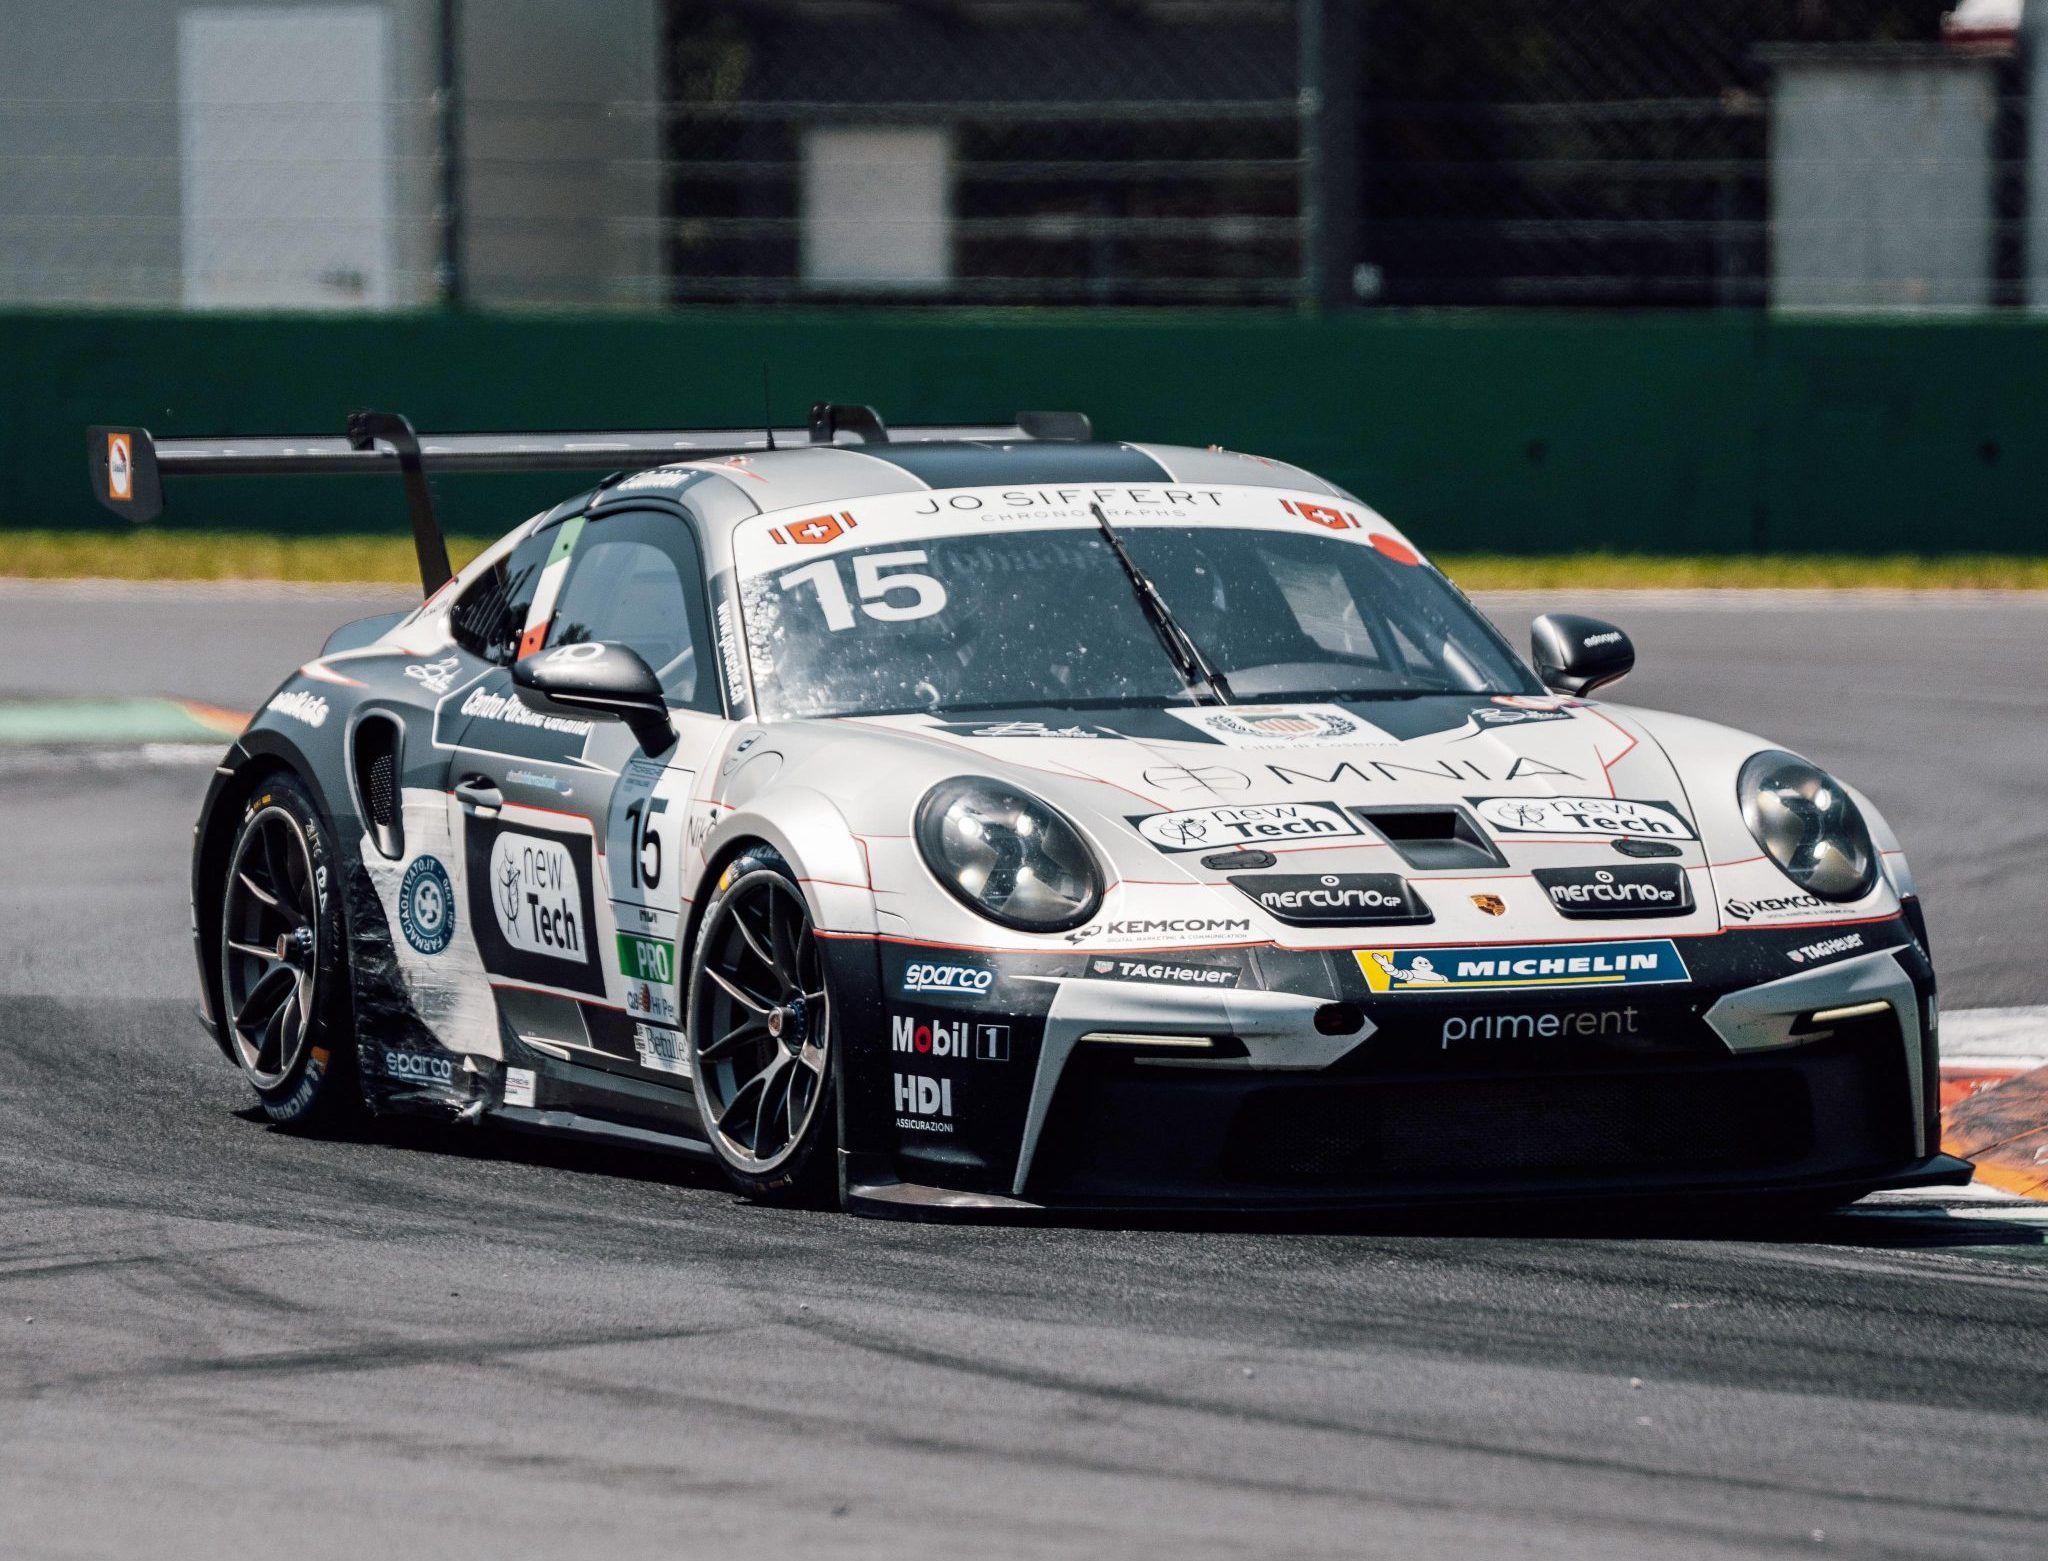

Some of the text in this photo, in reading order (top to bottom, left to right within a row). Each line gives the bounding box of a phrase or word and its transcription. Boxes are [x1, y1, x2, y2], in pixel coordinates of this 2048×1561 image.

[915, 489, 1223, 515] JO SIFFERT
[981, 508, 1187, 522] CHRONORAPHS
[780, 550, 948, 632] 15
[1210, 803, 1297, 822] new
[1549, 798, 1637, 815] new
[1225, 809, 1338, 838] Tech
[1562, 812, 1674, 835] Tech
[624, 797, 669, 890] 15
[523, 844, 563, 891] new
[526, 892, 579, 952] Tech
[1107, 919, 1250, 934] KEMCOMM
[637, 940, 669, 985] PRO
[1457, 953, 1658, 977] MICHELIN
[905, 963, 993, 991] sparco
[892, 1015, 997, 1057] Mobil 1
[1441, 1005, 1638, 1049] primerent
[386, 1051, 450, 1078] sparco
[893, 1073, 952, 1116] HDI
[895, 1117, 954, 1133] ASSICURAZIONI
